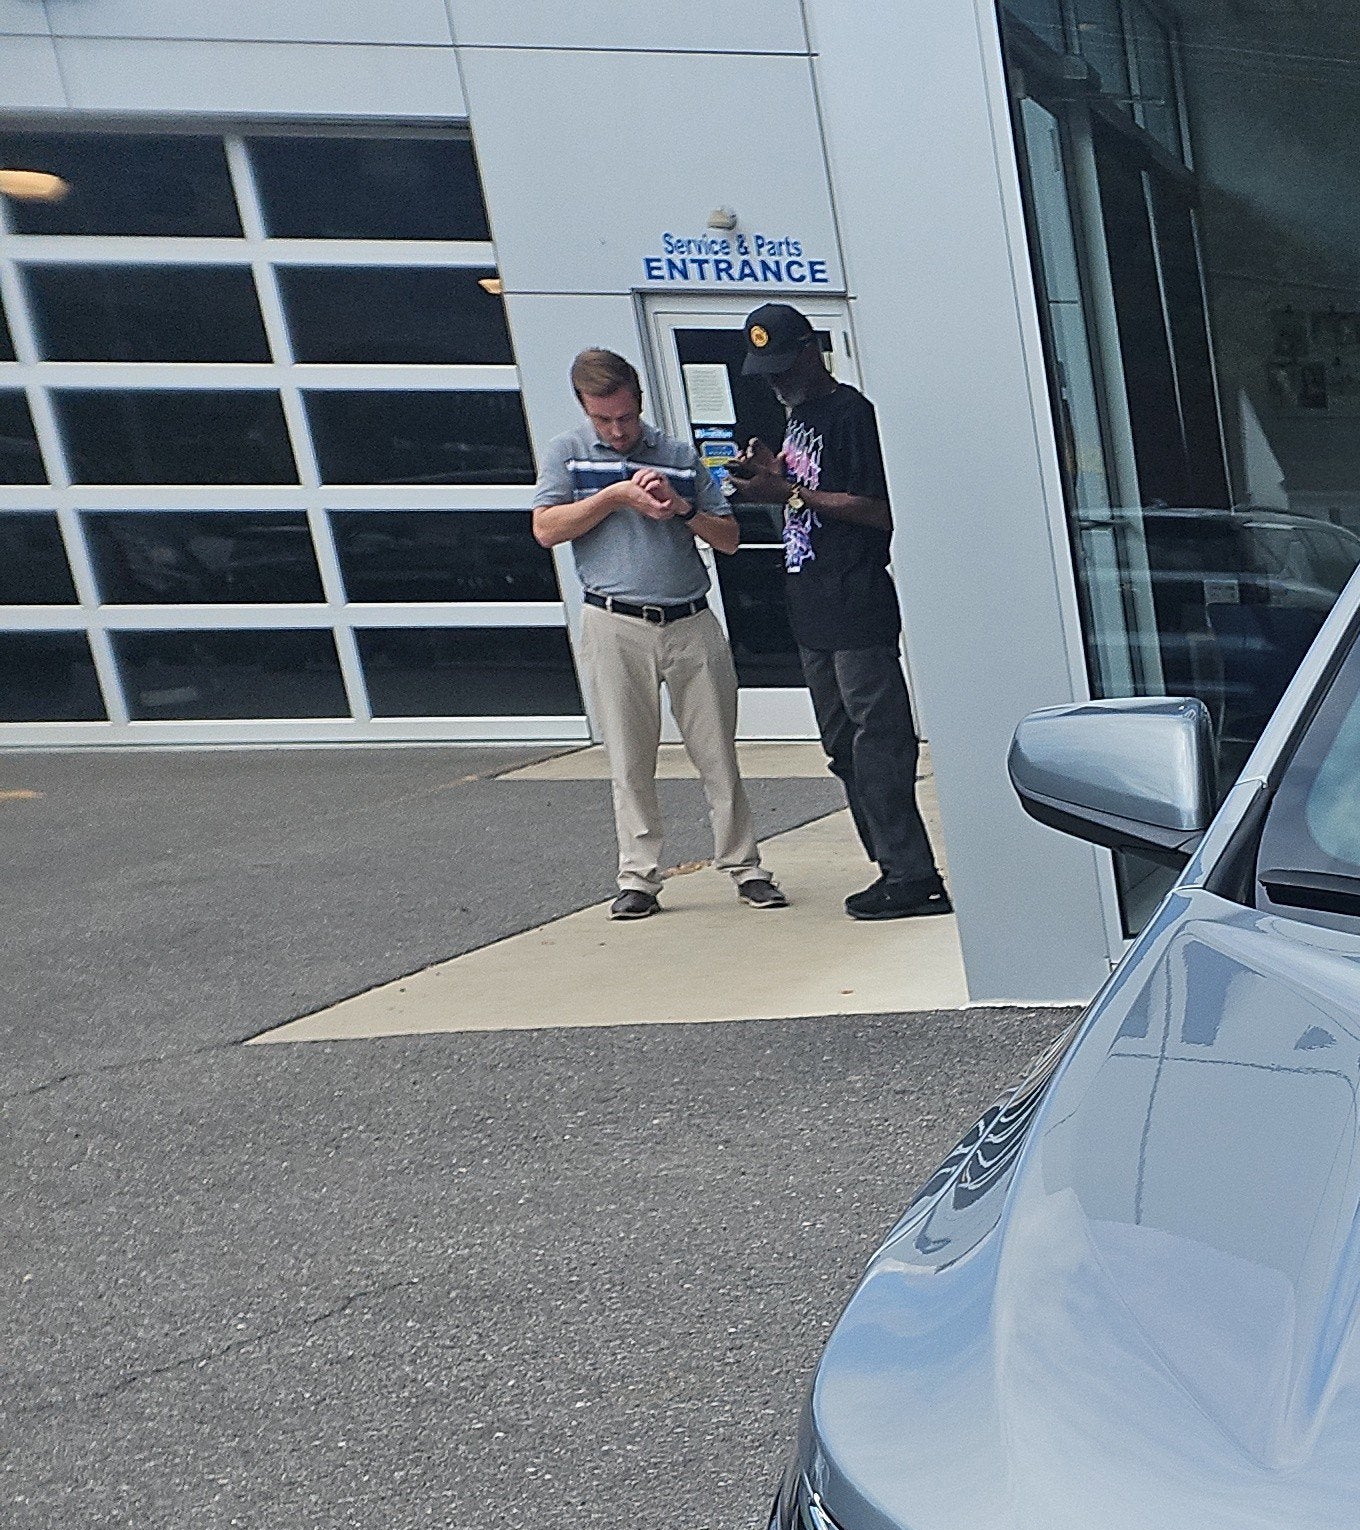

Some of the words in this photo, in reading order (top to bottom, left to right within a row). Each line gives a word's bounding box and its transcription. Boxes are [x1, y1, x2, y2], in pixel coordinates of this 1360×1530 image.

[663, 232, 731, 256] Service
[737, 234, 750, 256] &
[754, 235, 802, 257] Parts
[644, 257, 829, 283] ENTRANCE
